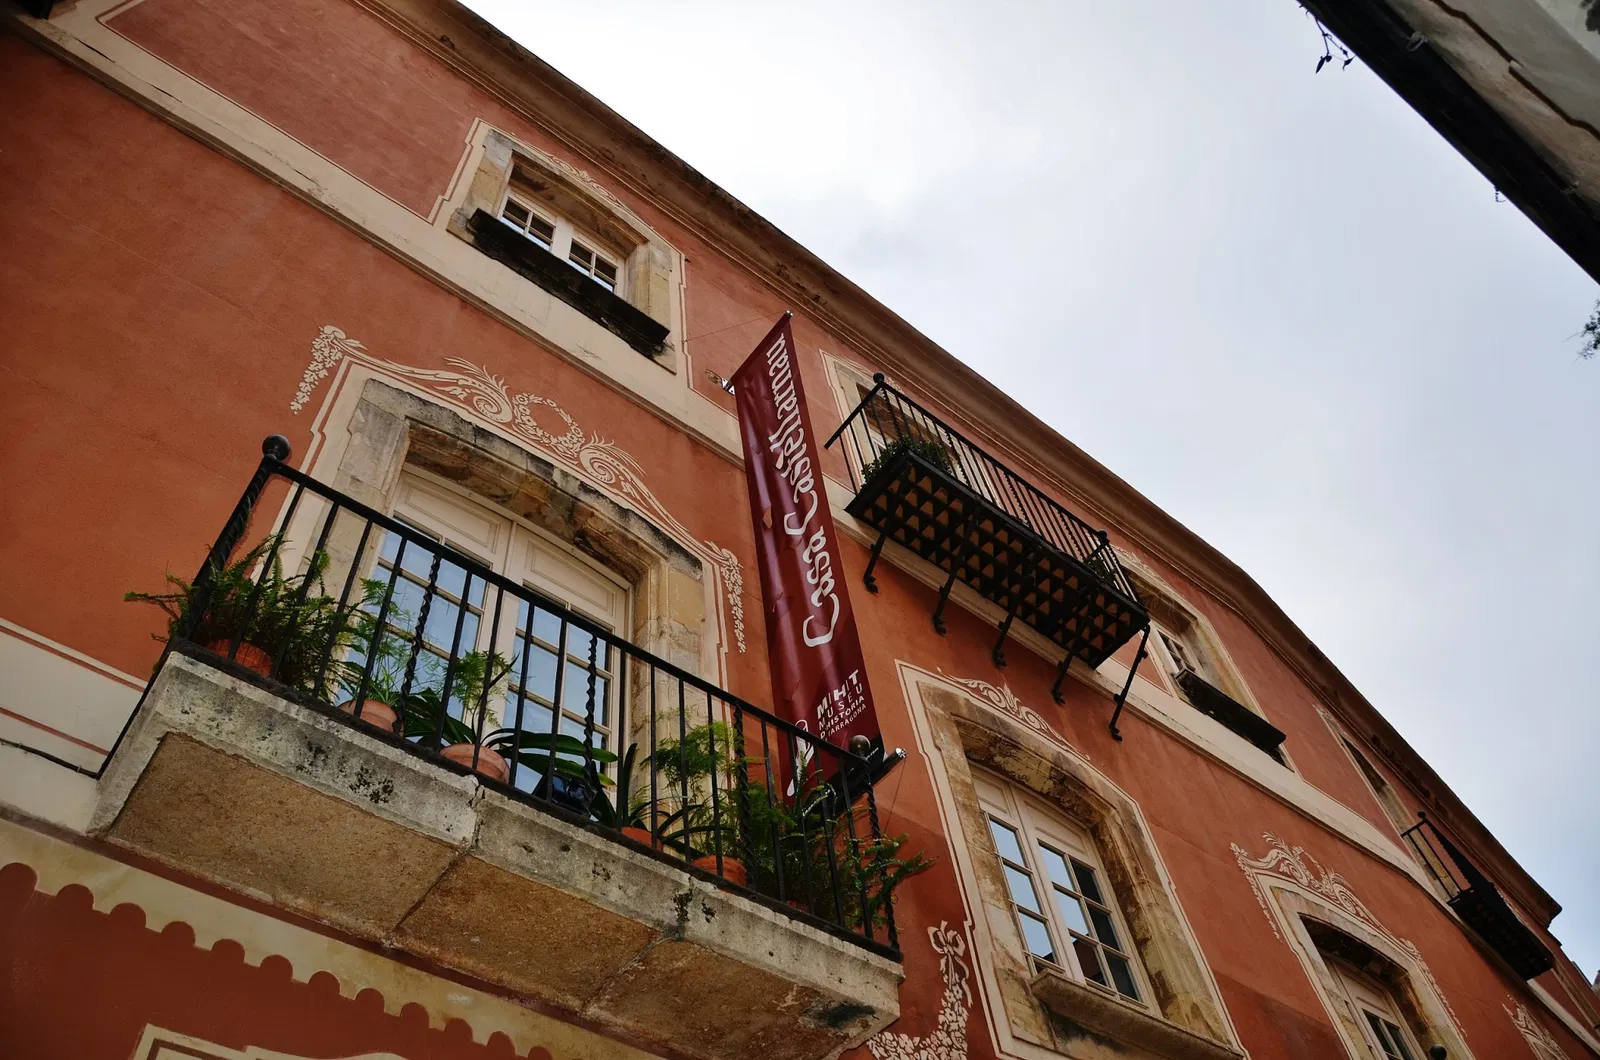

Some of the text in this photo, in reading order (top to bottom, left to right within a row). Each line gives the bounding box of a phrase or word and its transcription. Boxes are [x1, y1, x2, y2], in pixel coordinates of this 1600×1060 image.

[765, 332, 840, 648] Casa Castellarnau
[818, 682, 863, 731] MUSEU
